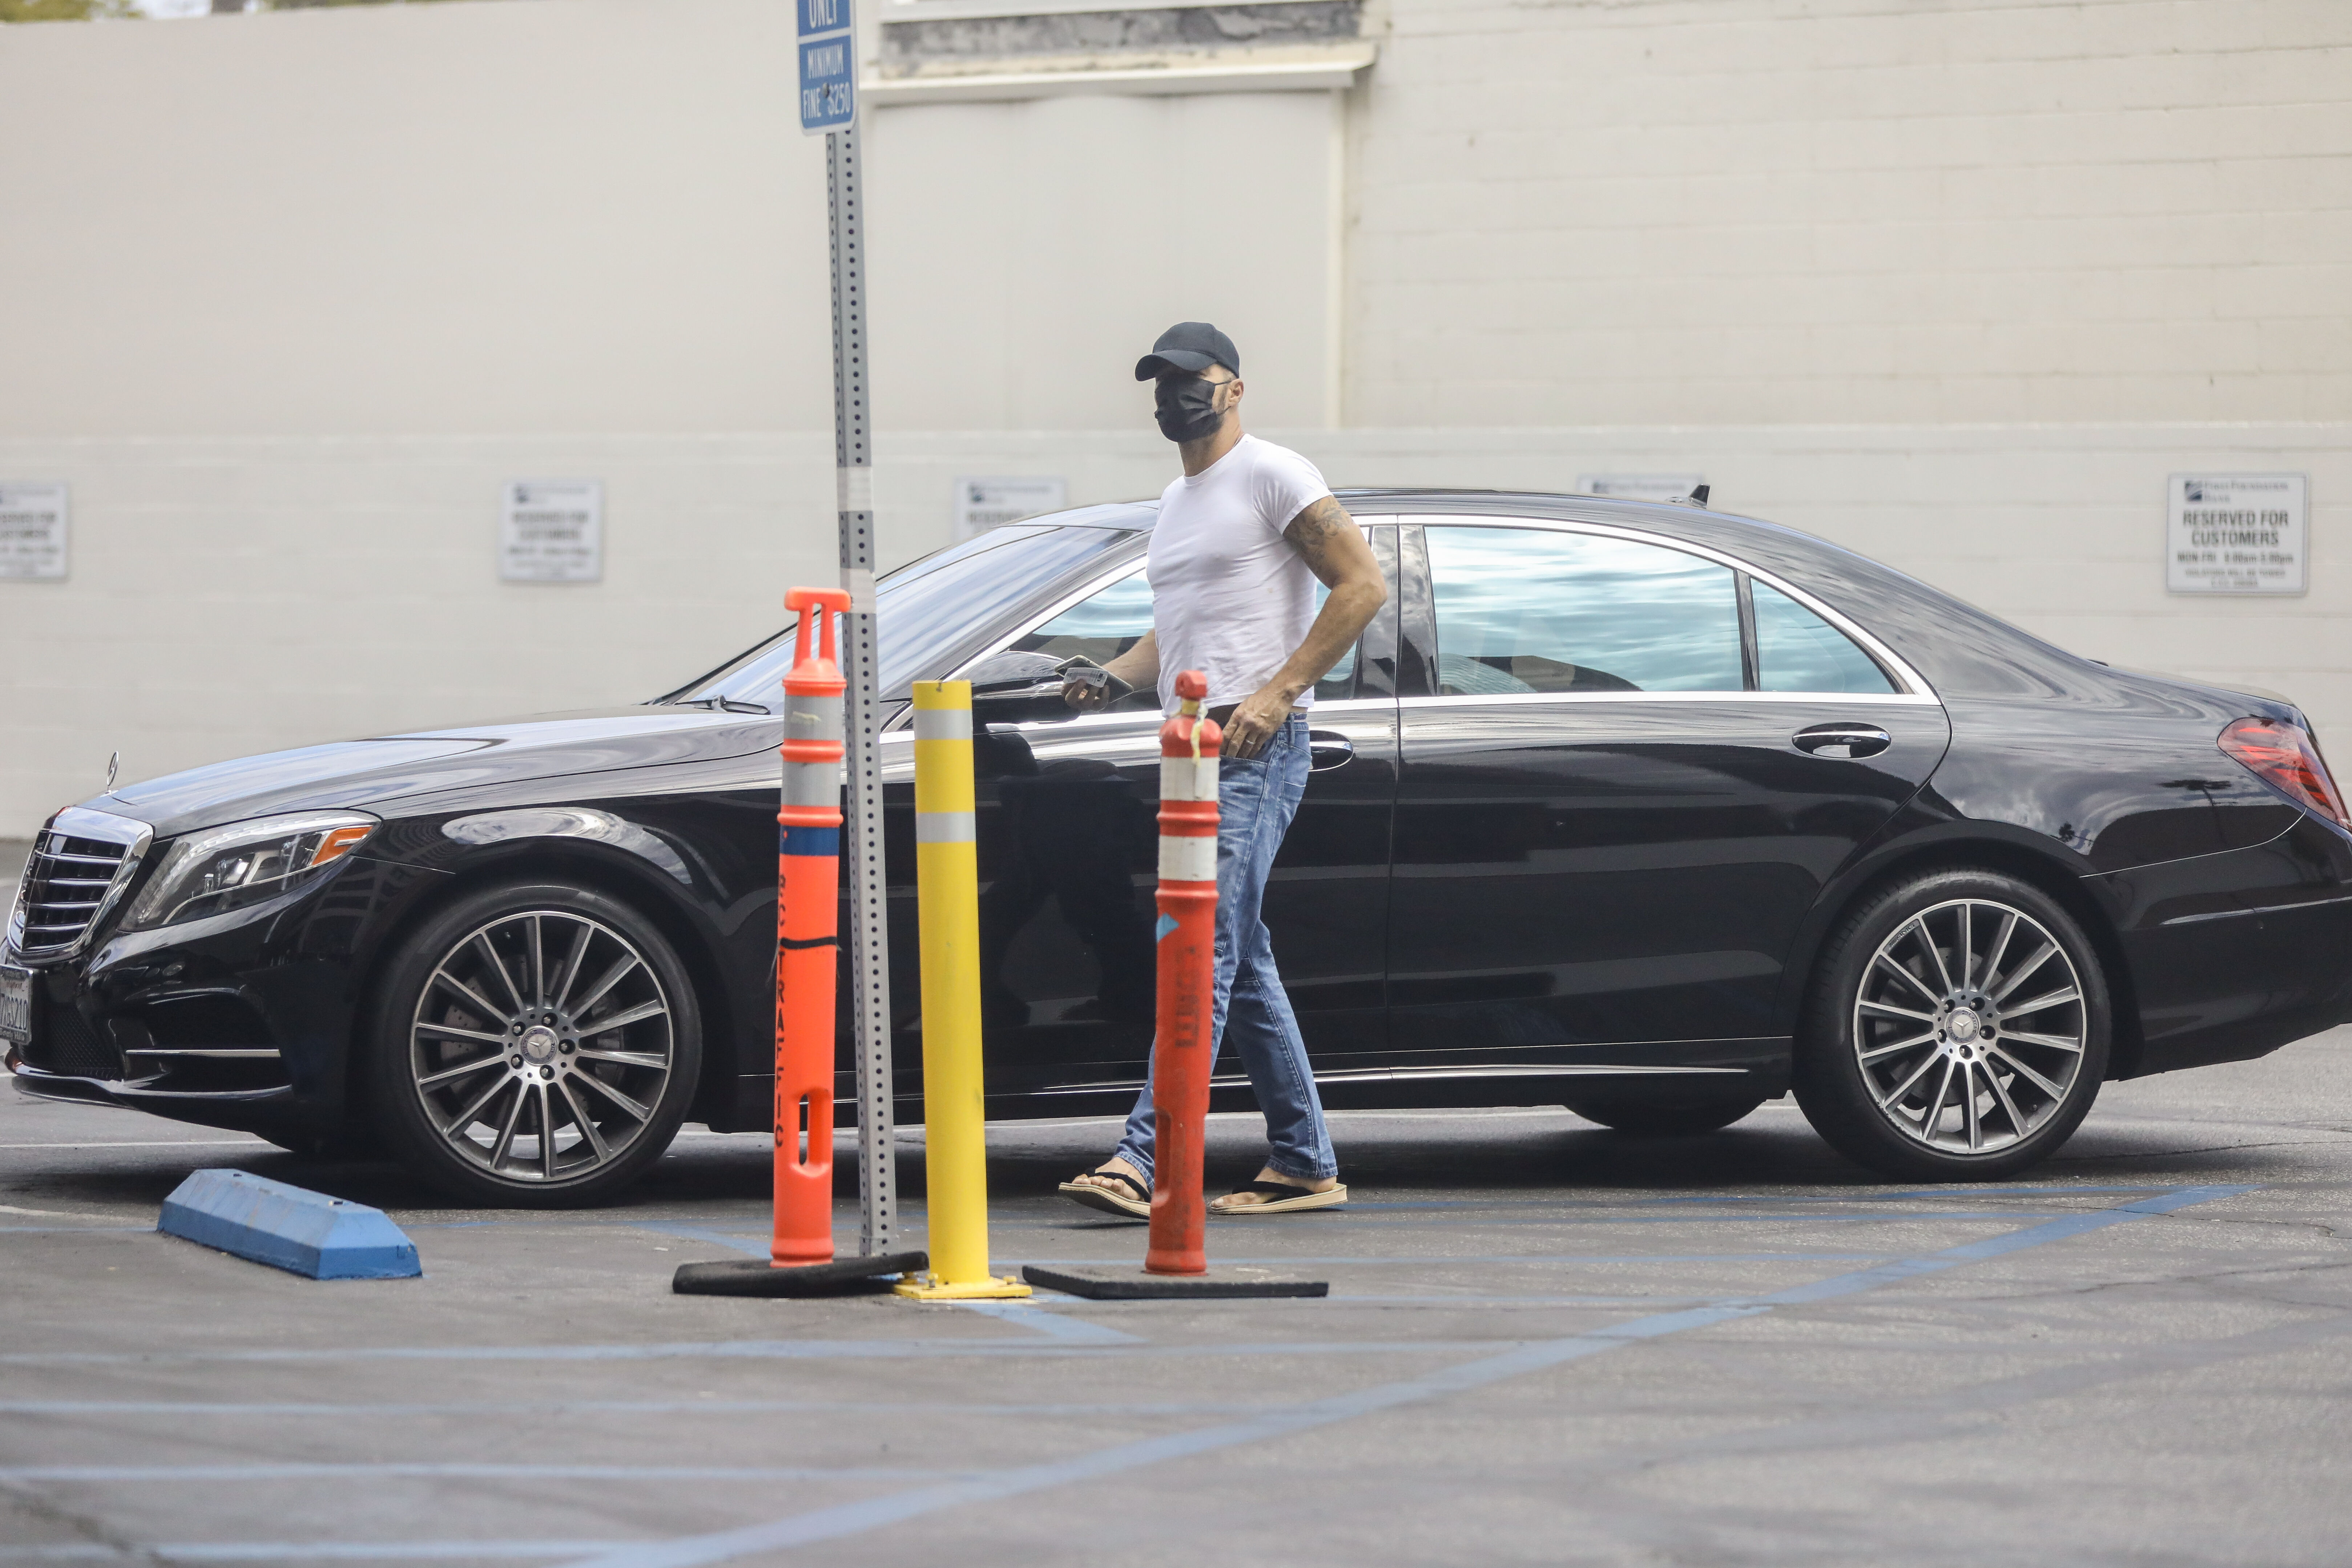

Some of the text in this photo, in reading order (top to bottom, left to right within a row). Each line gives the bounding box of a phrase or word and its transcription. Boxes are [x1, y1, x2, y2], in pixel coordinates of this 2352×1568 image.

[807, 43, 844, 79] MINIMUM
[803, 87, 822, 119] FINE
[2183, 510, 2289, 526] RESERVED FOR
[2191, 529, 2279, 547] CUSTOMERS
[776, 951, 785, 1147] TRAFFIC
